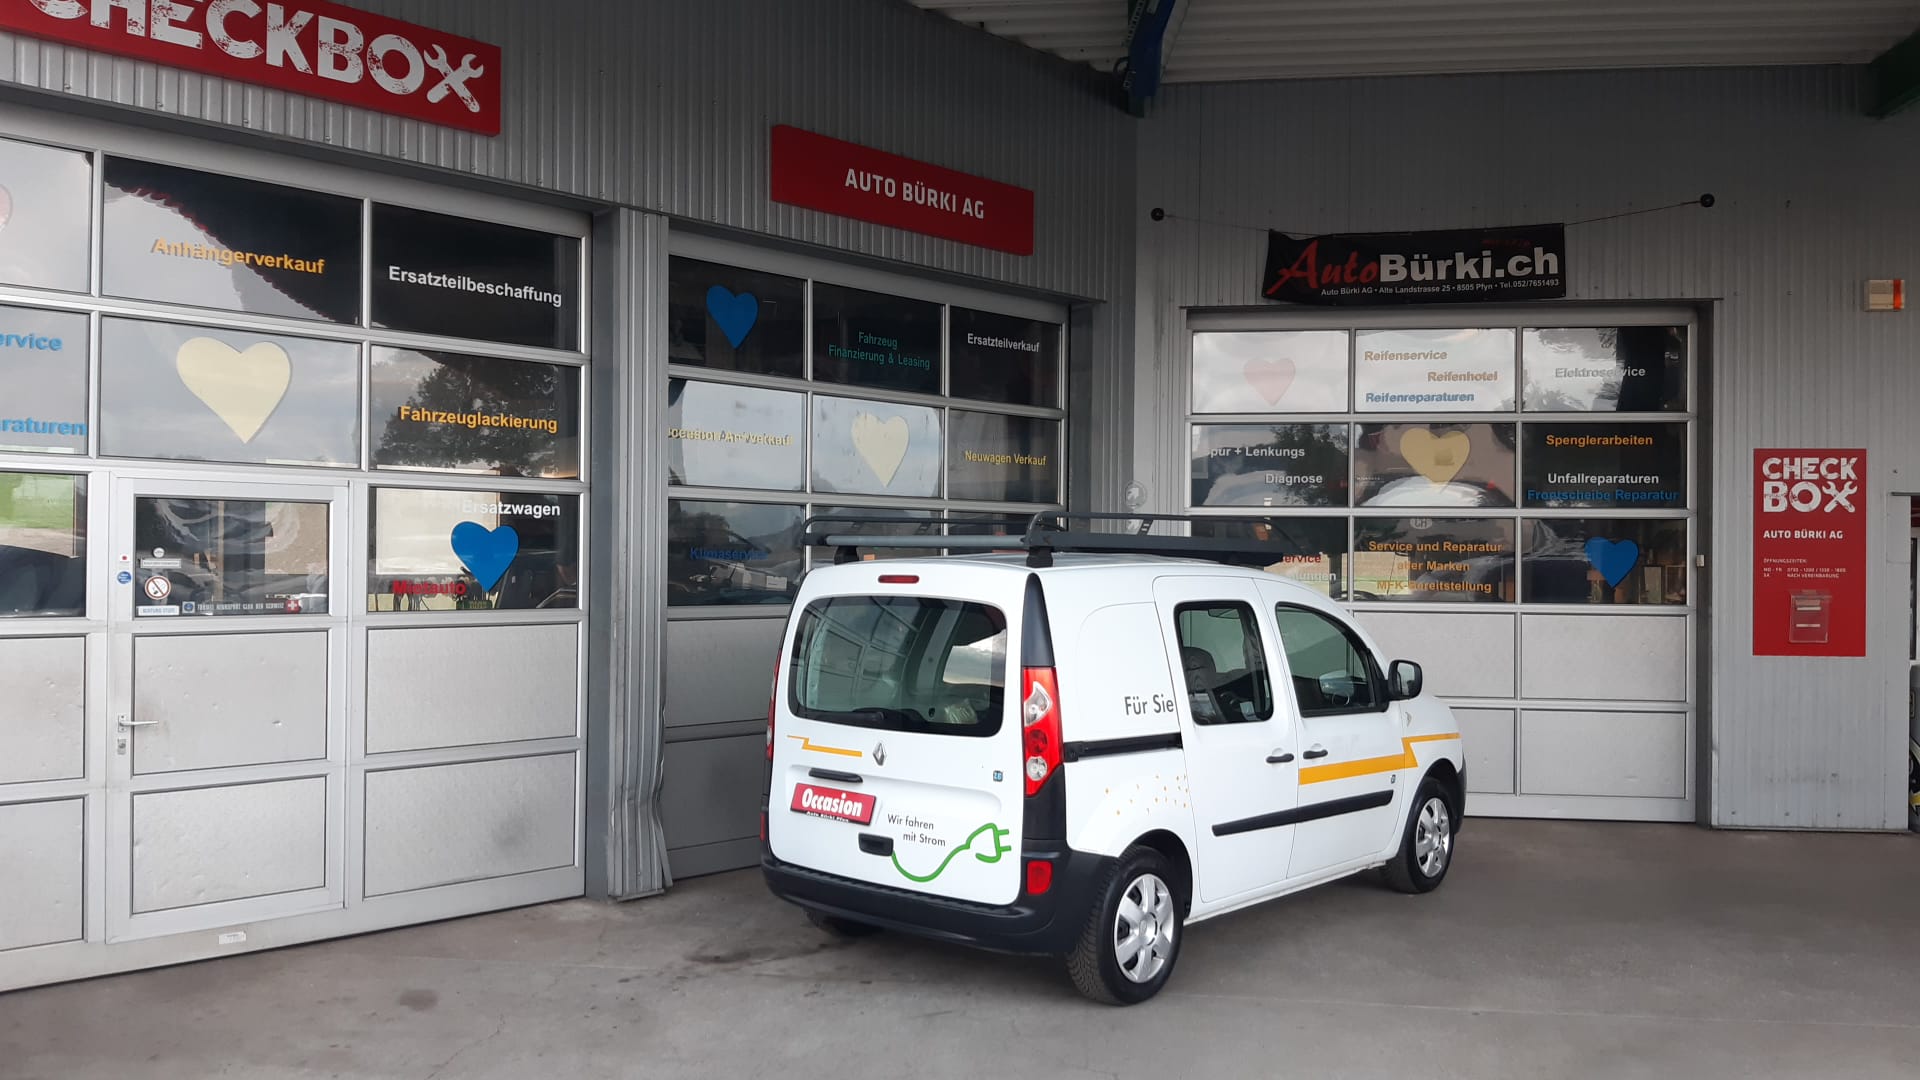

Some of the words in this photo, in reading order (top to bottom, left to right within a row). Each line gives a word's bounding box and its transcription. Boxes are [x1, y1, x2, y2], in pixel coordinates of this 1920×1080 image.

[845, 168, 896, 198] AUTO
[902, 181, 957, 213] BÜRKI
[962, 198, 985, 219] AG
[152, 237, 325, 275] Anhängerverkauf
[388, 265, 562, 307] Ersatzteilbeschaffung
[1341, 286, 1360, 294] Bürki
[1395, 286, 1440, 294] Landstrasse
[858, 331, 898, 350] Fahrzeug
[967, 332, 1040, 353] Ersatzteilverkauf
[828, 344, 884, 365] Finanzierung
[887, 353, 894, 365] &
[898, 353, 930, 371] Leasing
[1364, 350, 1448, 361] Reifenservice
[1427, 371, 1498, 382] Reifenhotel
[1555, 367, 1646, 378] Elektroservice
[1365, 392, 1475, 404] Reifenreparaturen
[0, 417, 87, 436] raturen
[400, 405, 557, 433] Fahrzeuglackierung
[1546, 434, 1653, 447] Spenglerarbeiten
[965, 450, 1011, 465] Neuwagen
[1013, 453, 1047, 466] Verkauf
[1246, 446, 1305, 459] Lenkungs
[1763, 457, 1858, 480] CHECK
[1265, 473, 1323, 486] Diagnose
[1548, 473, 1659, 486] Unfallreparaturen
[1527, 489, 1611, 501] Frontscheibe
[1615, 489, 1680, 502] Reparatur
[462, 500, 561, 518] Ersatzwagen
[1763, 530, 1791, 539] AUTO
[1794, 528, 1826, 539] BÜRKI
[1829, 530, 1843, 539] AG
[1369, 541, 1413, 552] Service
[1417, 541, 1439, 552] und
[1443, 541, 1504, 553] Reparatur
[1281, 554, 1322, 563] ervice
[1426, 561, 1470, 571] Marken
[392, 580, 467, 595] Mietauto
[1377, 579, 1492, 593] MFK-Bereitstellung
[1124, 696, 1148, 716] Für
[1152, 693, 1174, 713] Sie
[802, 788, 863, 817] Occasion
[887, 813, 903, 826] Wir
[905, 815, 934, 831] fahren
[903, 832, 917, 843] mit
[919, 834, 946, 847] Strom
